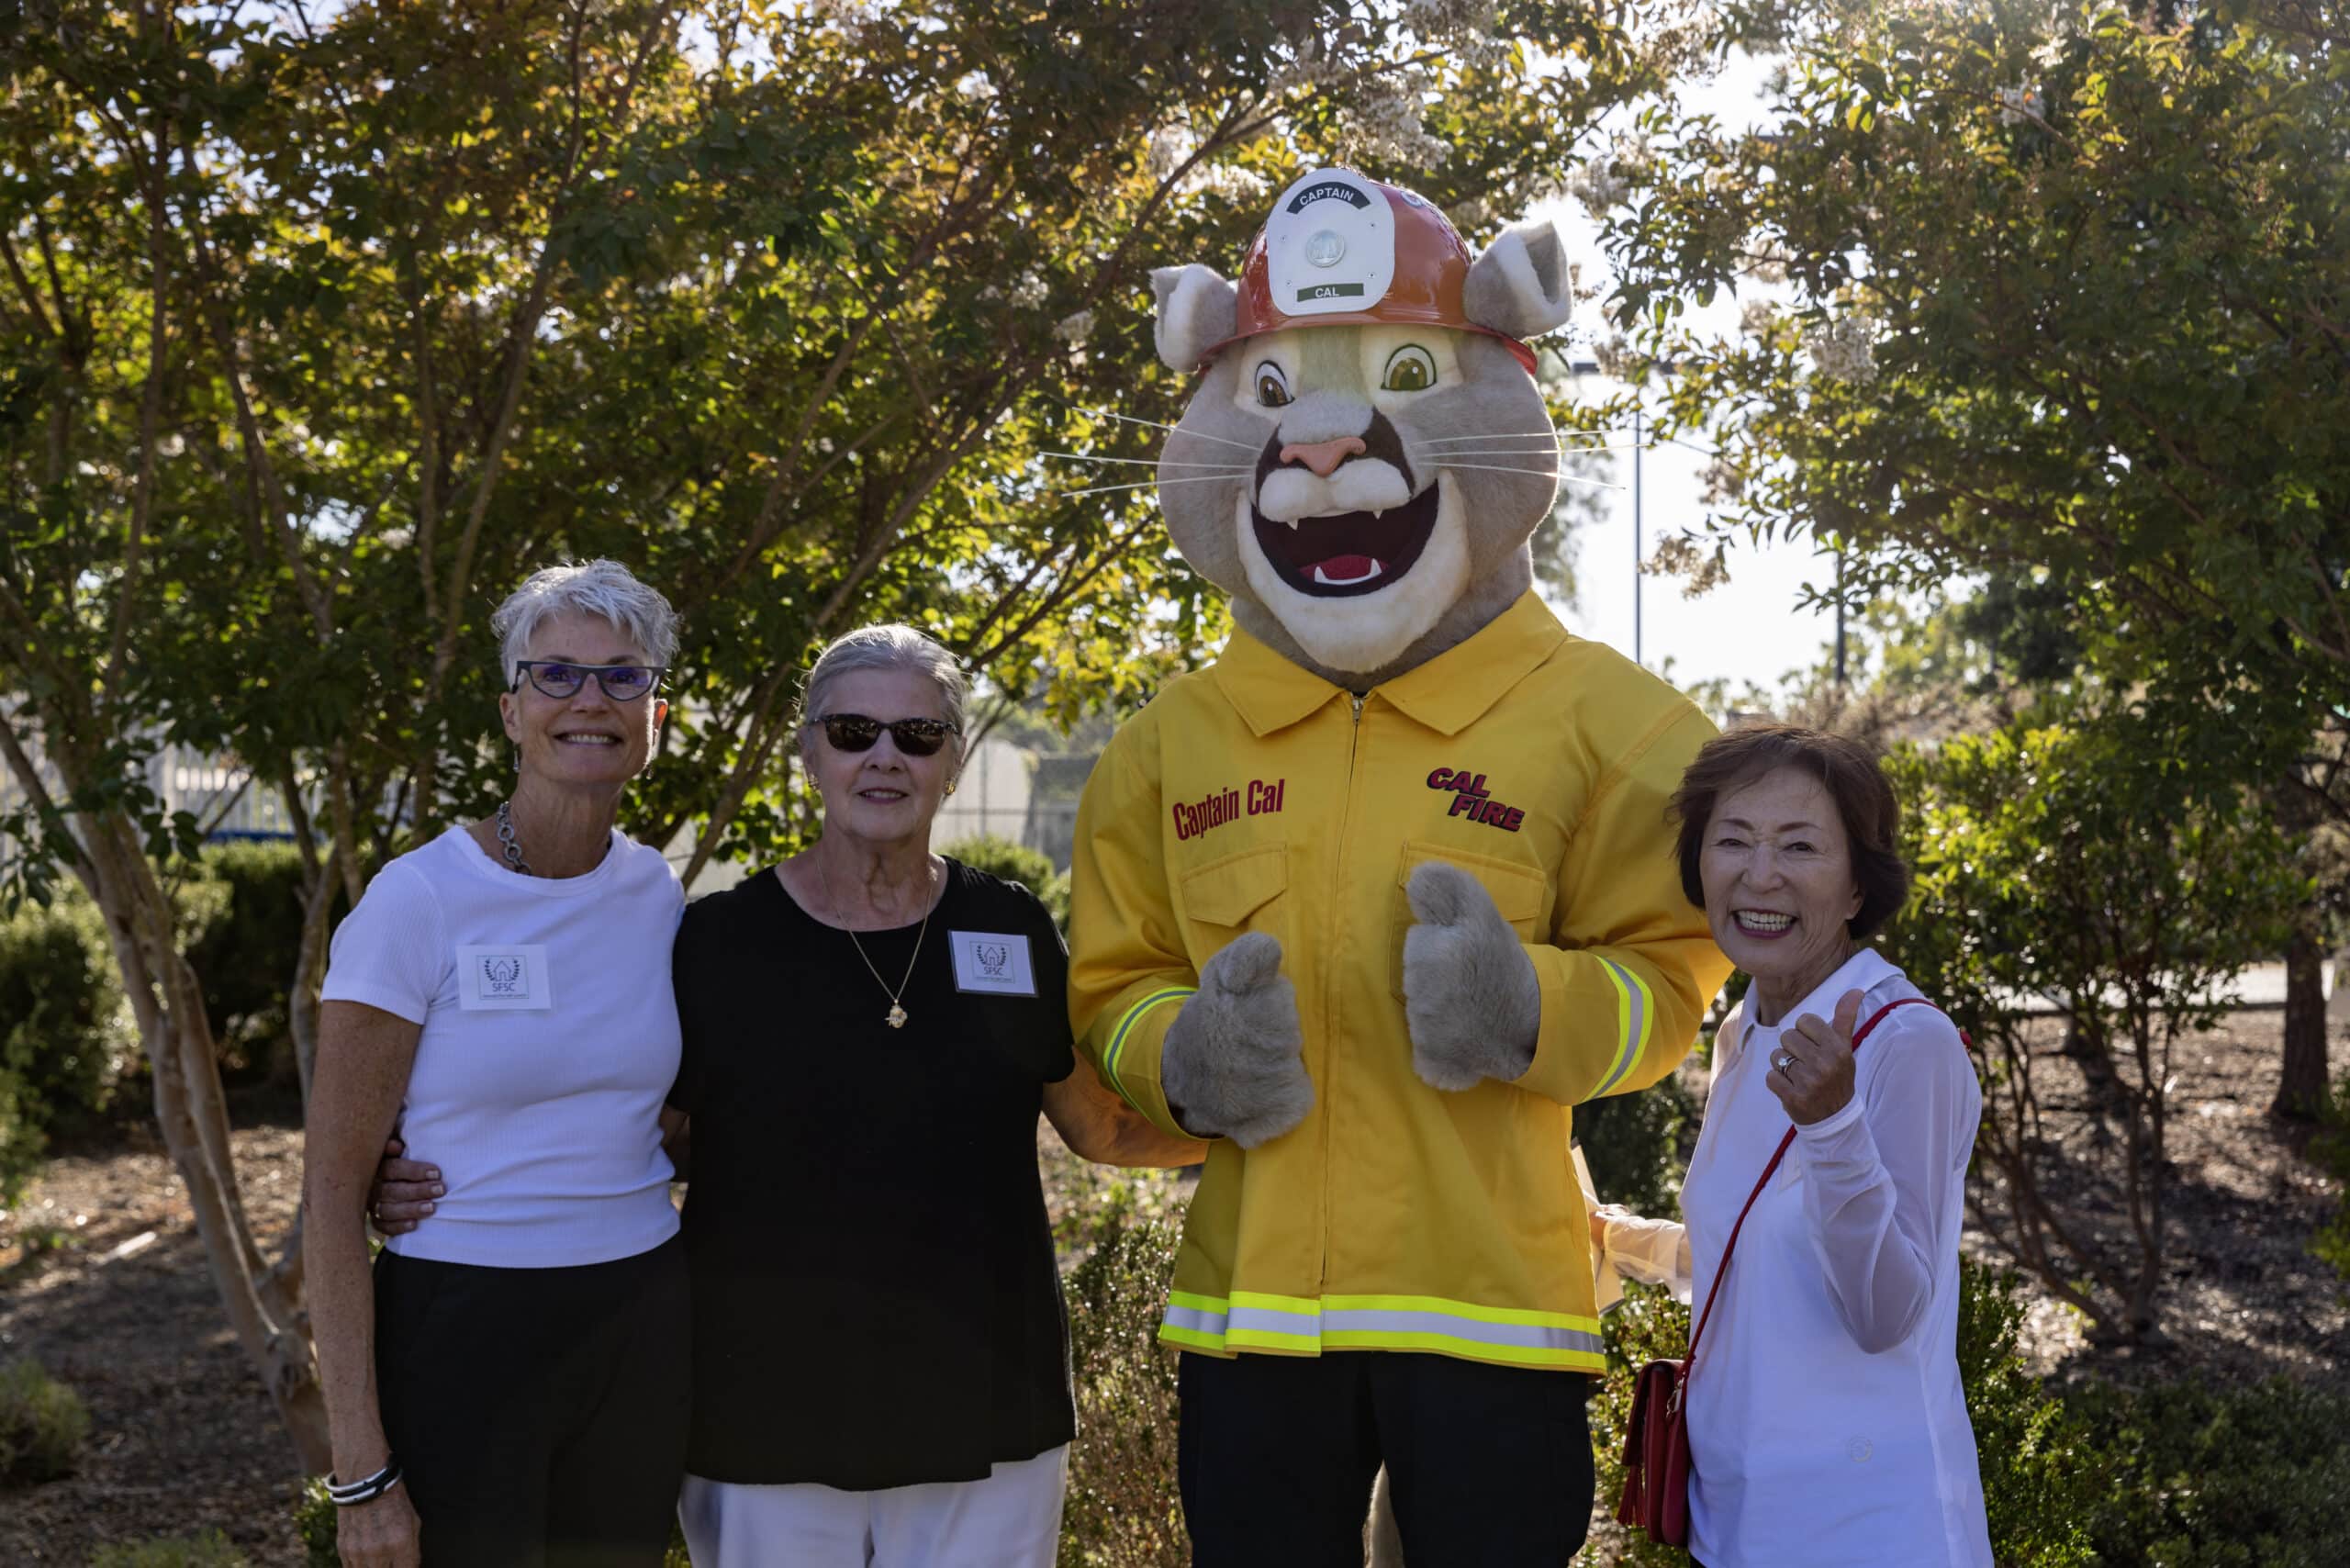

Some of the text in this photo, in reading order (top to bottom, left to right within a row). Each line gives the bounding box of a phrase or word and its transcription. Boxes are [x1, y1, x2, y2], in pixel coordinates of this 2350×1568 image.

[1299, 187, 1355, 206] CAPTAIN
[1315, 287, 1340, 298] CAL
[1427, 767, 1492, 799] CAL
[1172, 778, 1285, 841] Captain Cal
[1447, 794, 1526, 833] FIRE
[491, 982, 516, 992] SFSC
